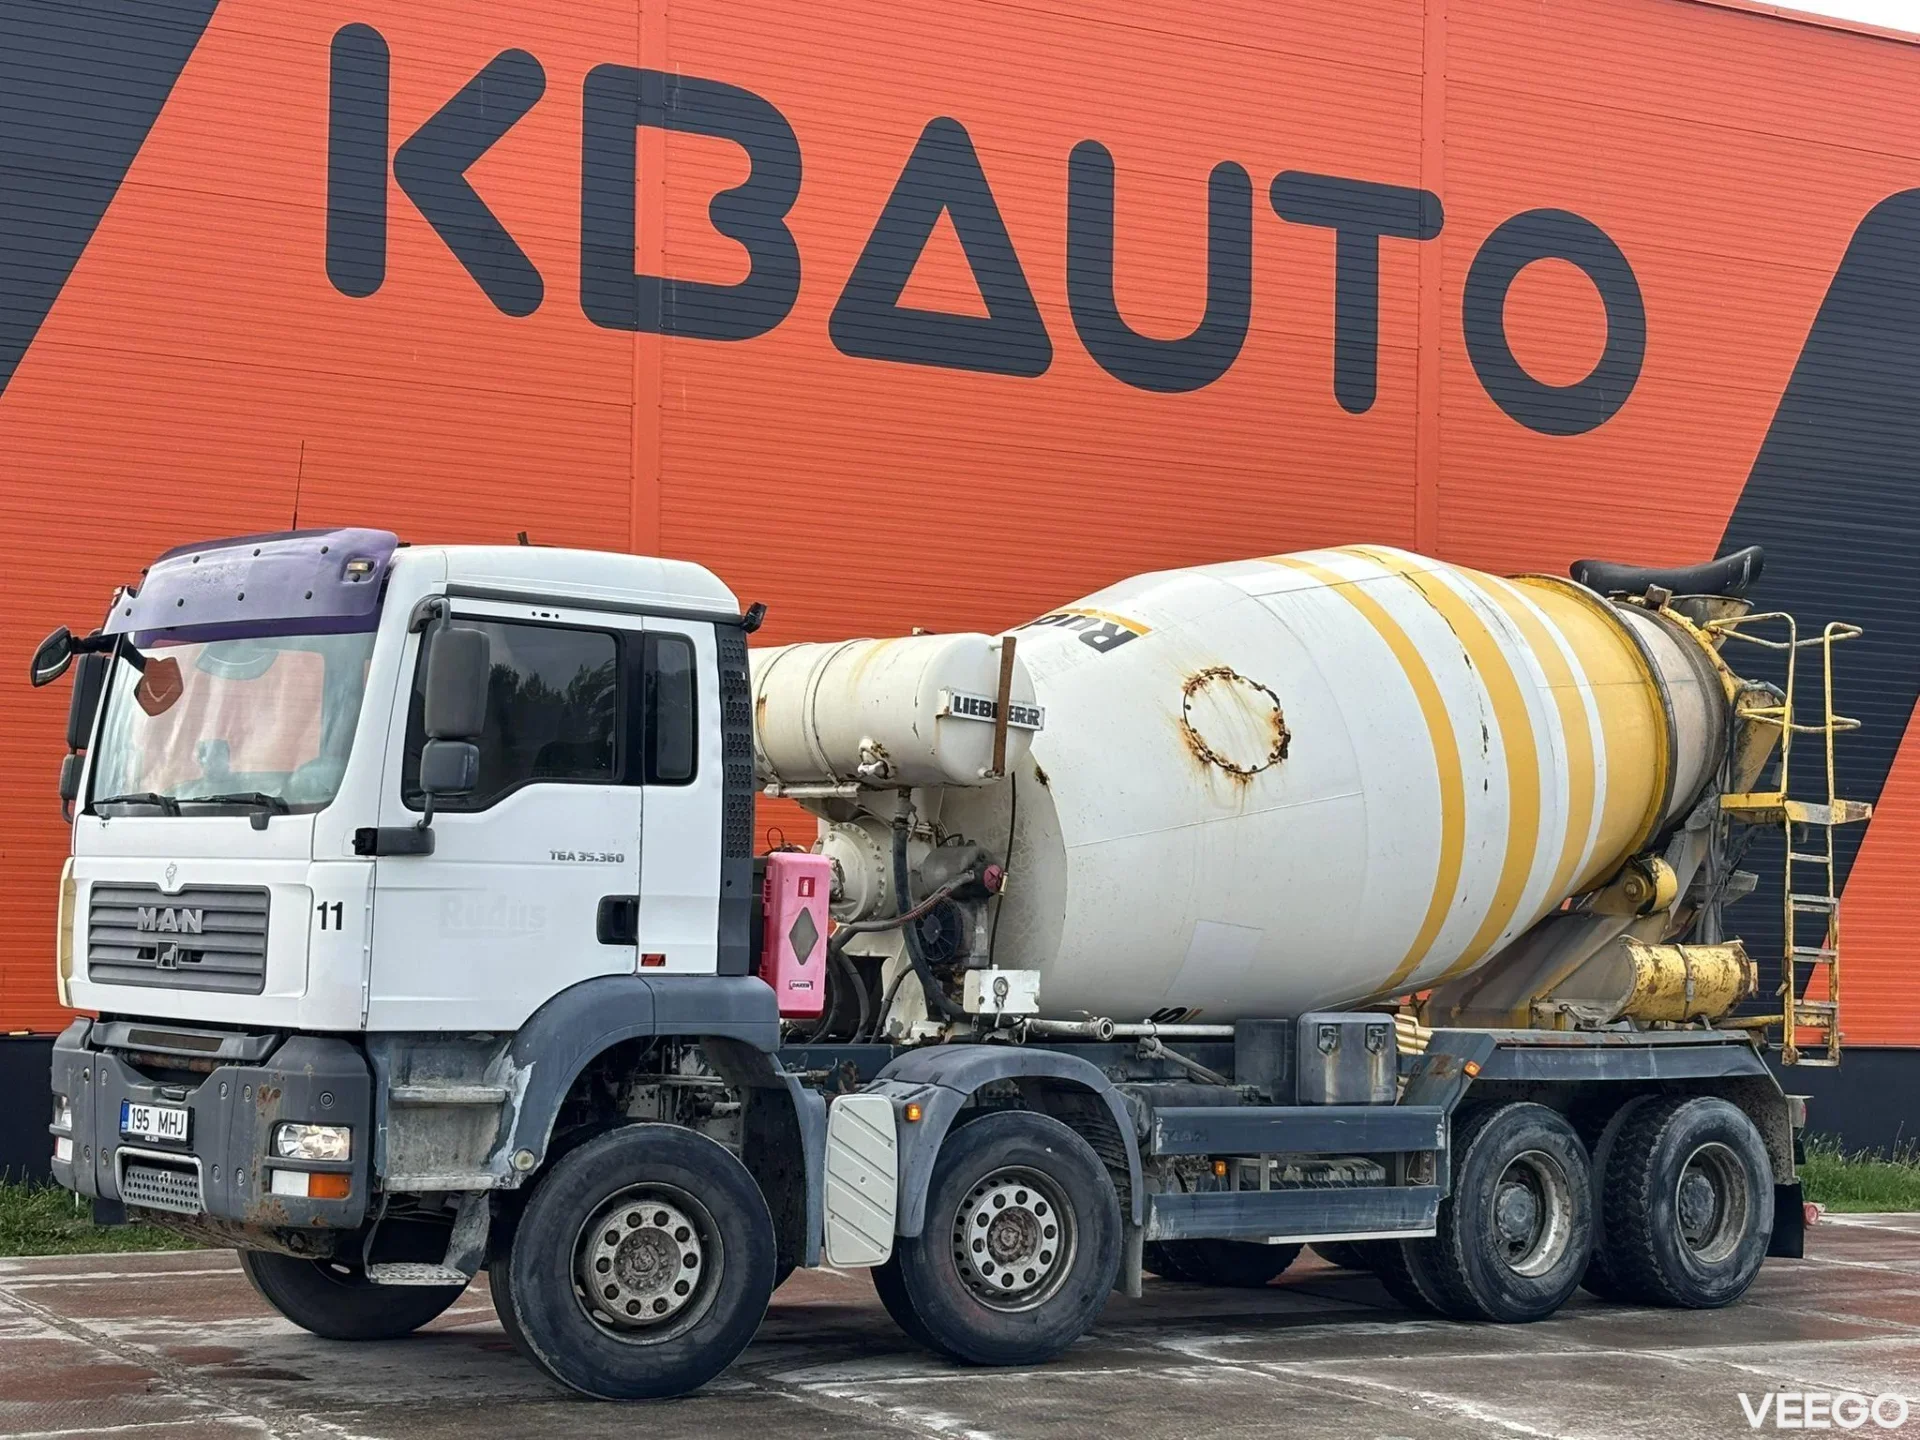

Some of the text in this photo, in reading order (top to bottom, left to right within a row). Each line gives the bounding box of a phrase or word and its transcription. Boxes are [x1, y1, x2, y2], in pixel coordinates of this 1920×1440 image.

[549, 850, 625, 863] TGA 35.360
[137, 906, 203, 934] MAN
[317, 901, 343, 931] 11
[132, 1107, 184, 1135] 195 MHJ
